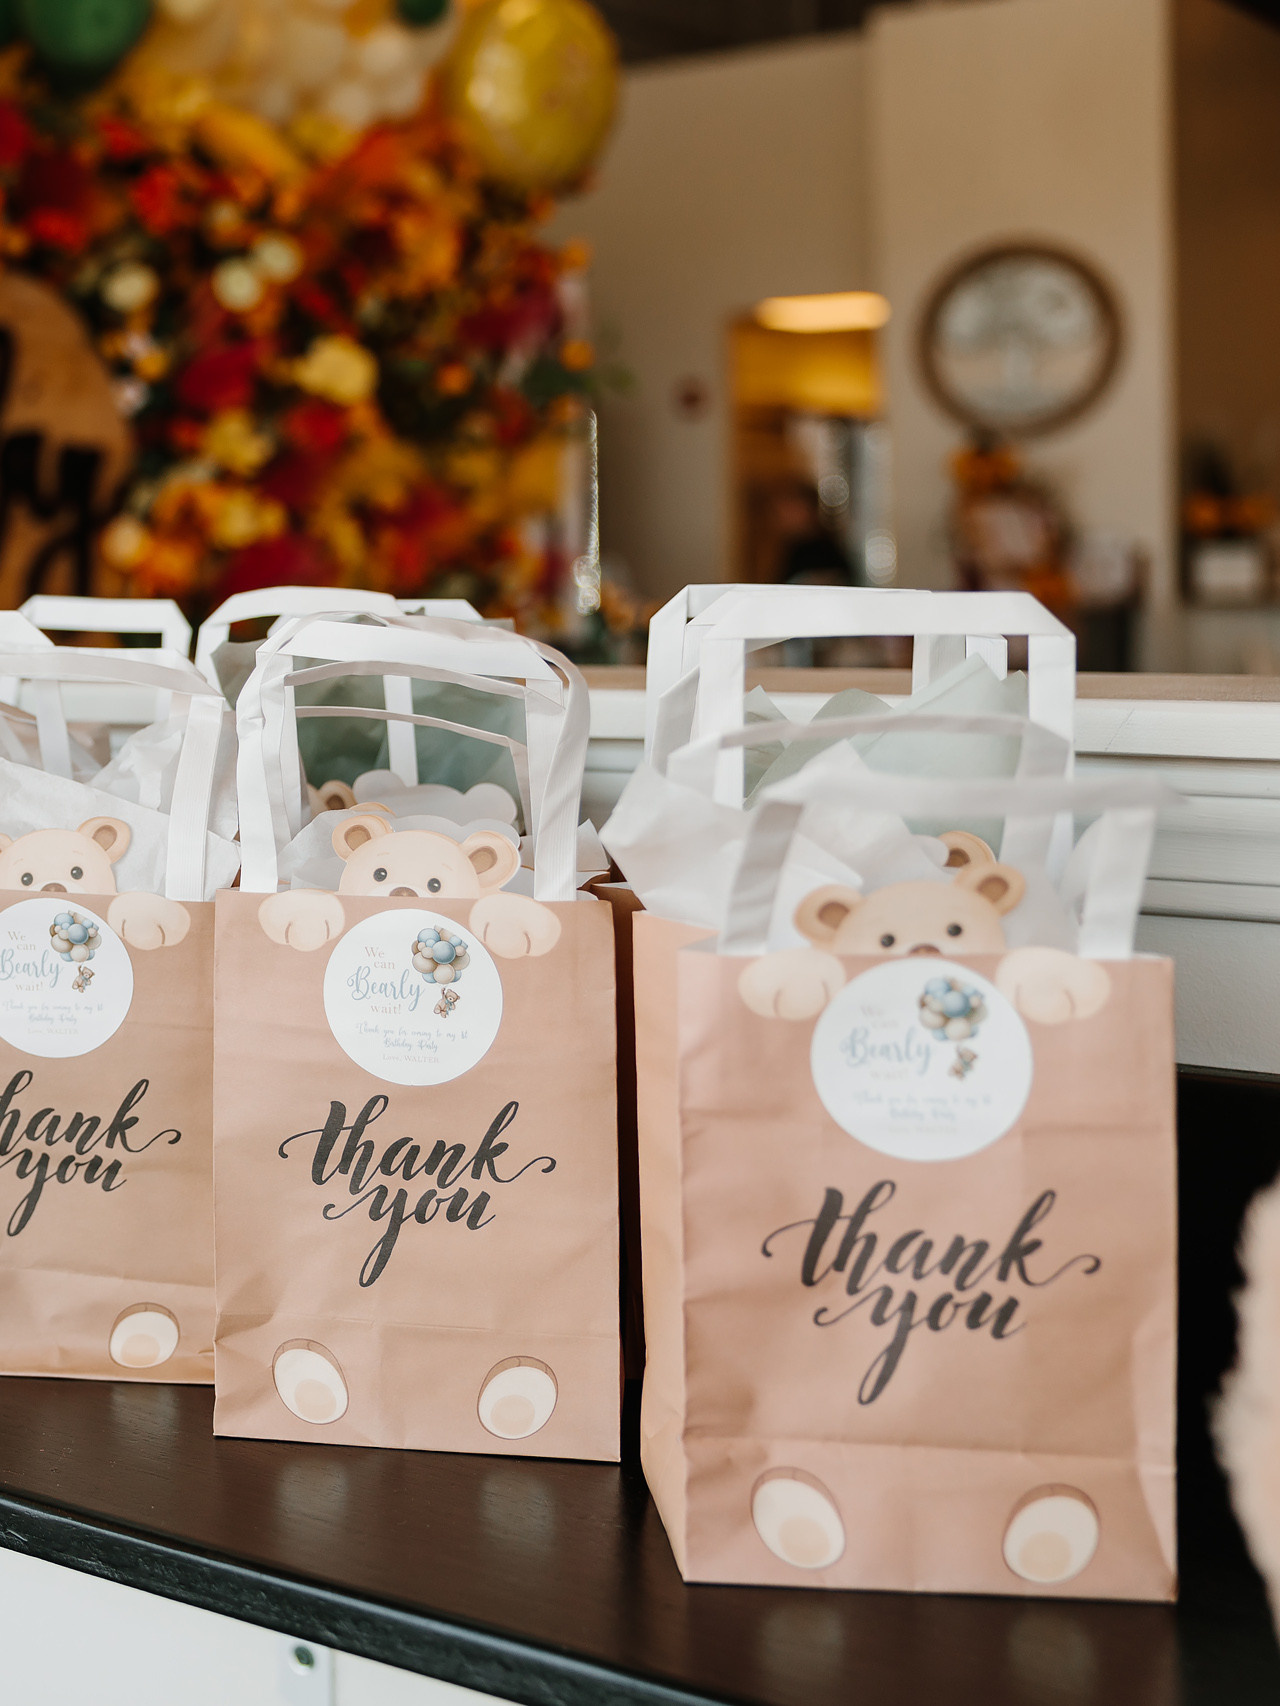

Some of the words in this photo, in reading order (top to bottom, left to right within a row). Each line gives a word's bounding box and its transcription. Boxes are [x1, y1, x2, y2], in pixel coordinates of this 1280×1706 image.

[8, 930, 26, 941] We
[16, 943, 36, 951] can
[365, 946, 384, 958] We
[374, 960, 395, 969] can
[15, 982, 43, 991] wait!
[347, 965, 424, 1012] Bearly
[370, 1003, 401, 1014] wait!
[383, 1038, 412, 1051] Birthday
[418, 1040, 438, 1052] Party
[839, 1025, 932, 1076] Bearly
[278, 1094, 556, 1195] thank
[322, 1184, 496, 1288] you
[761, 1180, 1101, 1296] thank
[813, 1285, 1027, 1405] you
